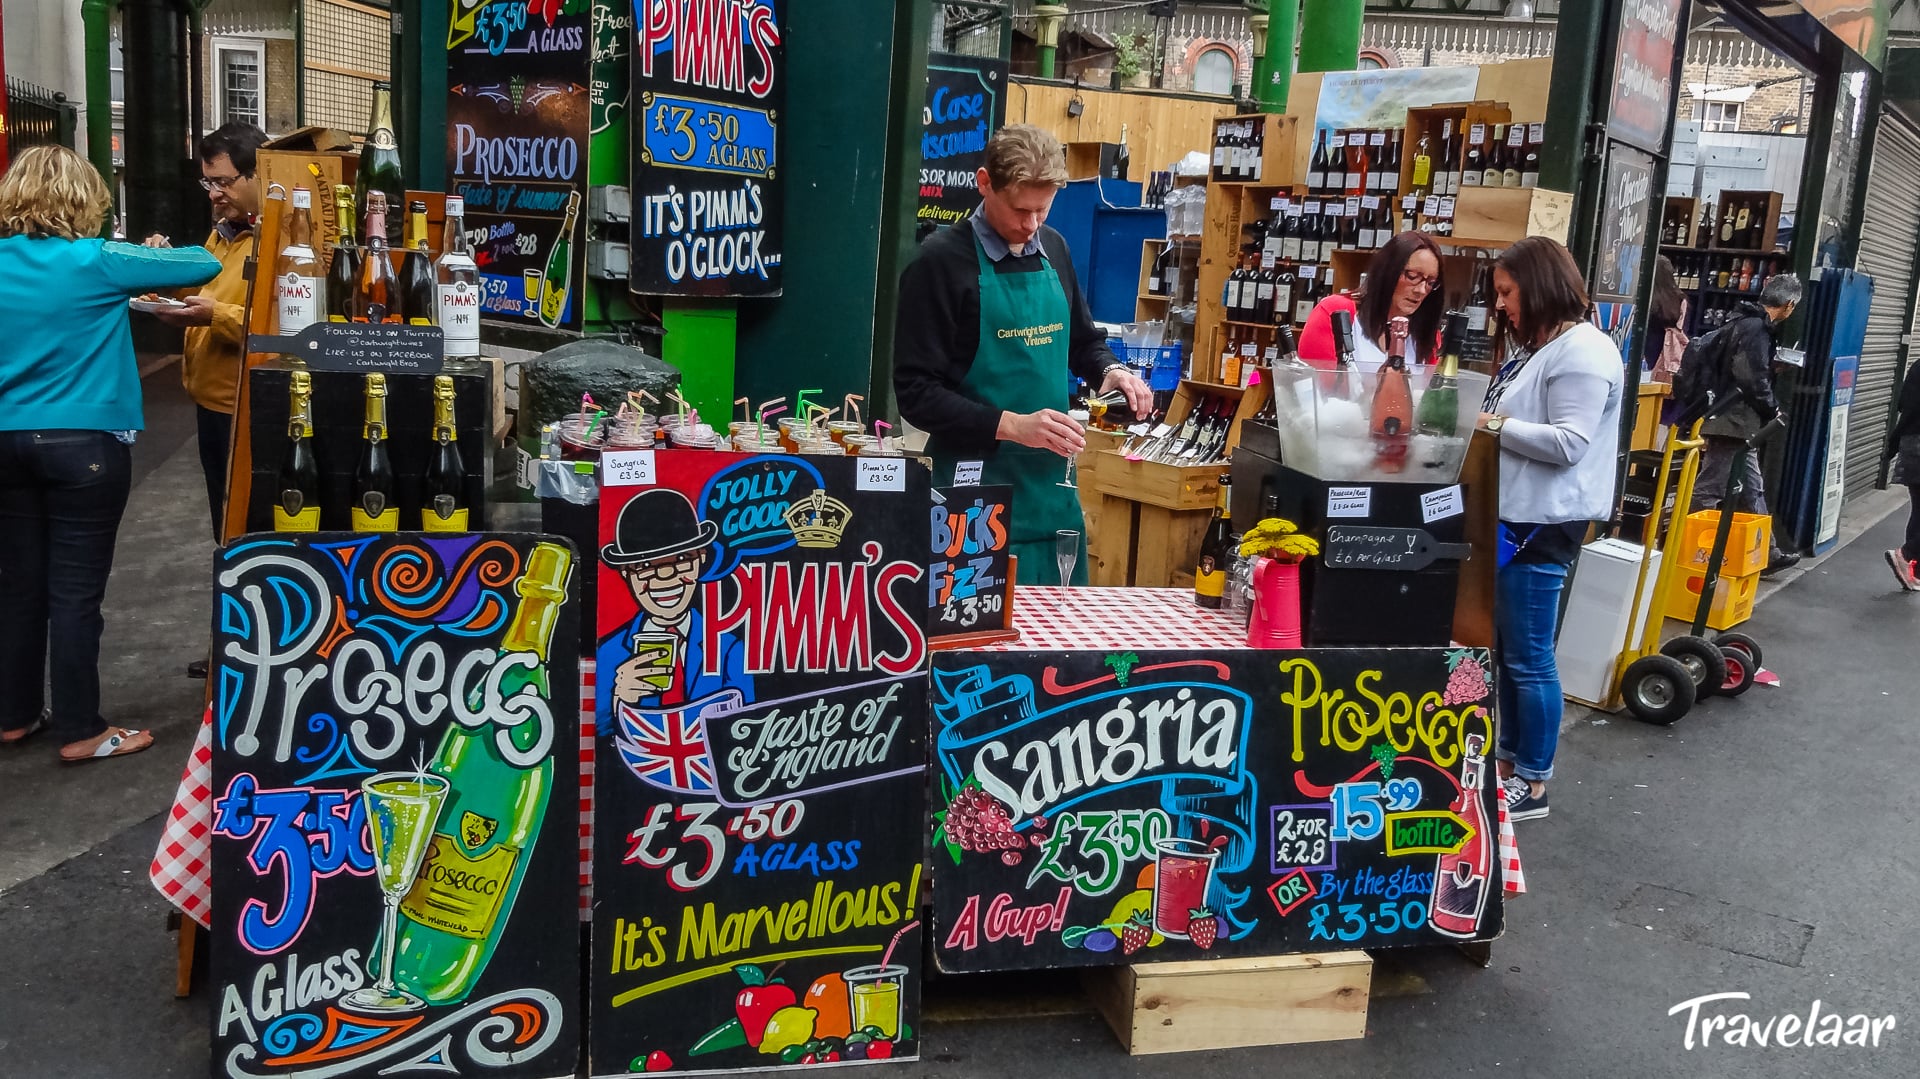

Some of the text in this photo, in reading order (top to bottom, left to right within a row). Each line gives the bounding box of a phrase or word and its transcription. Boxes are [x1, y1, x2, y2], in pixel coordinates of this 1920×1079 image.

[528, 26, 584, 54] A GLASS
[642, 0, 774, 98] PIMM'S
[932, 86, 984, 125] Case
[453, 123, 578, 185] PROSECCO
[719, 147, 767, 171] GLASS
[921, 119, 987, 160] iscount
[496, 183, 517, 213] of
[919, 185, 943, 198] MIX
[930, 169, 946, 187] OR
[945, 170, 978, 190] MOR
[644, 178, 764, 237] IT'S PIMM'S
[279, 285, 312, 300] PIMM'S
[444, 292, 477, 306] PIMM'S
[997, 327, 1038, 338] Cartwright
[610, 458, 647, 470] Sangria
[887, 464, 899, 472] Cup
[710, 469, 798, 510] JOLLY
[722, 499, 793, 538] GOOD
[930, 498, 1007, 558] BUCKS
[1330, 530, 1395, 547] Champagne
[701, 541, 927, 677] PIMM'S
[219, 554, 554, 769] Prosecco
[730, 682, 904, 767] Taste of
[727, 715, 903, 799] England
[973, 687, 1237, 825] Sangria
[1296, 818, 1327, 838] FOR
[420, 843, 499, 896] Prosecco
[761, 840, 862, 876] GLASS
[1277, 839, 1326, 864] £28
[1277, 864, 1434, 905] OR By the glass
[611, 863, 923, 975] It's Marvellous!
[945, 886, 1073, 951] A Cup!
[219, 948, 365, 1043] A Glass
